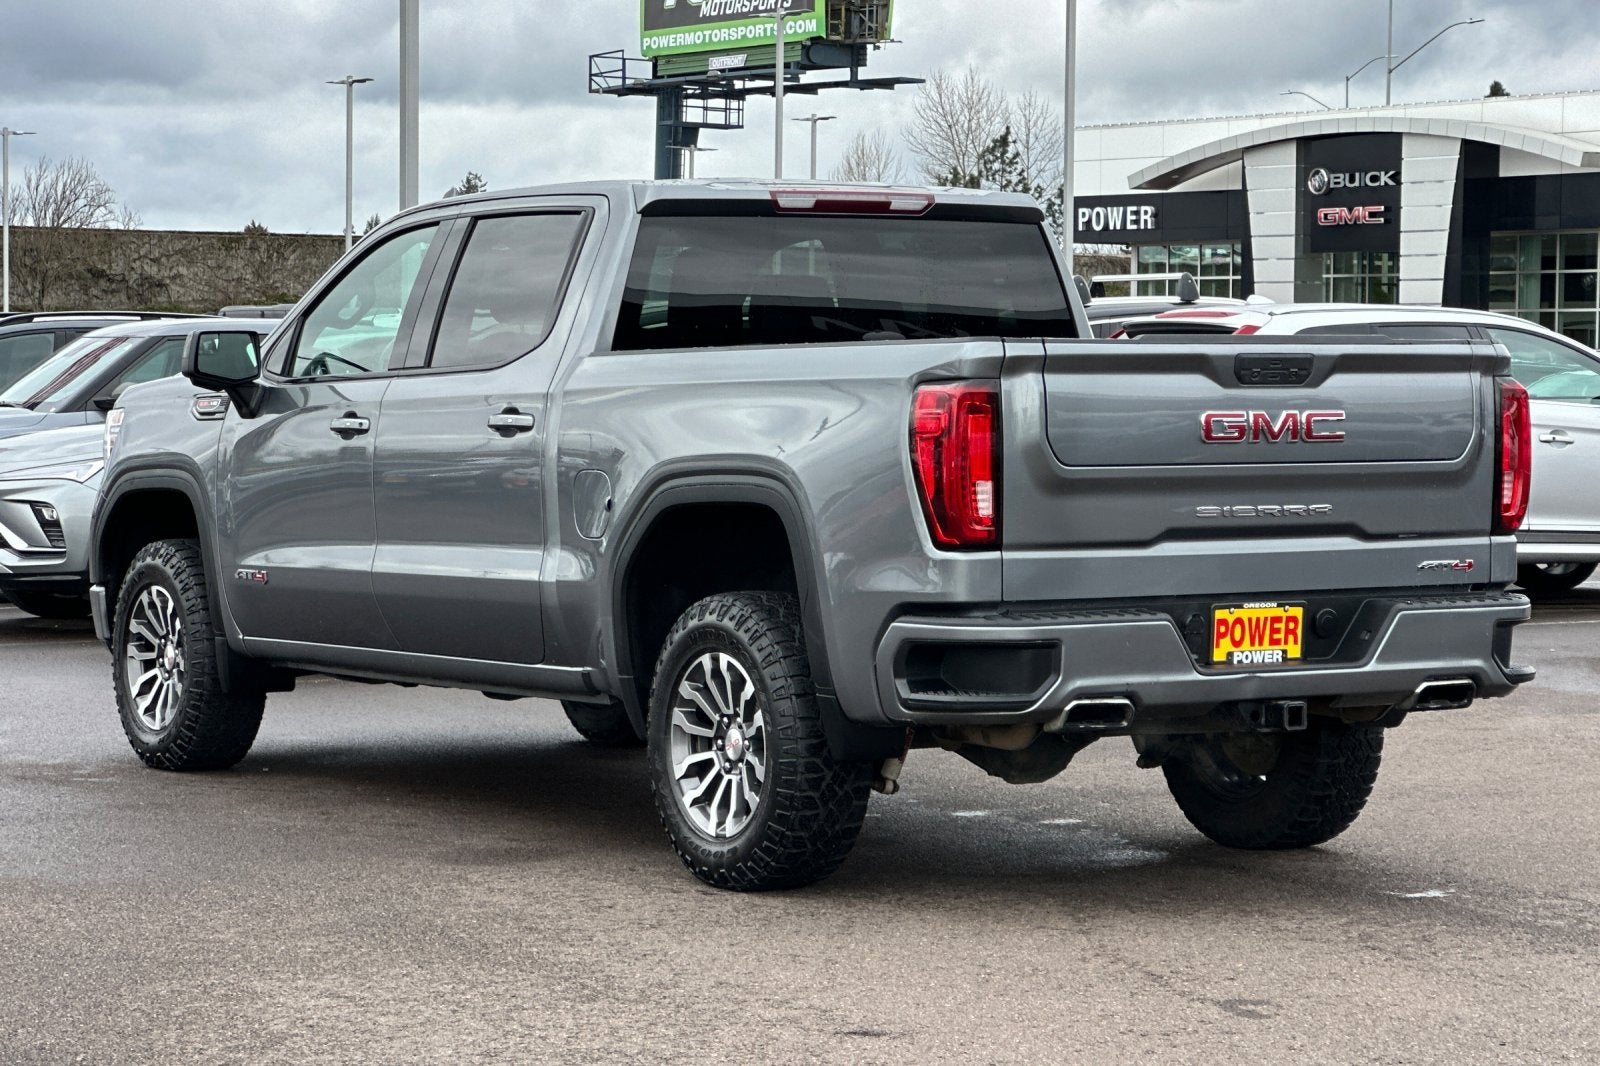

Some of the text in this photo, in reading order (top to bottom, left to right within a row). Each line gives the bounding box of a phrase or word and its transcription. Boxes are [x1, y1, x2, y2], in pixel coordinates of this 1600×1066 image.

[1329, 170, 1397, 188] BUICK
[1078, 205, 1156, 232] POWER
[1317, 205, 1385, 225] GMC
[1200, 410, 1346, 443] GMC
[1196, 504, 1333, 518] SIERRA
[1417, 559, 1474, 573] AT4
[234, 568, 268, 585] AT4
[1215, 616, 1300, 649] POWER
[1233, 650, 1283, 665] POWER
